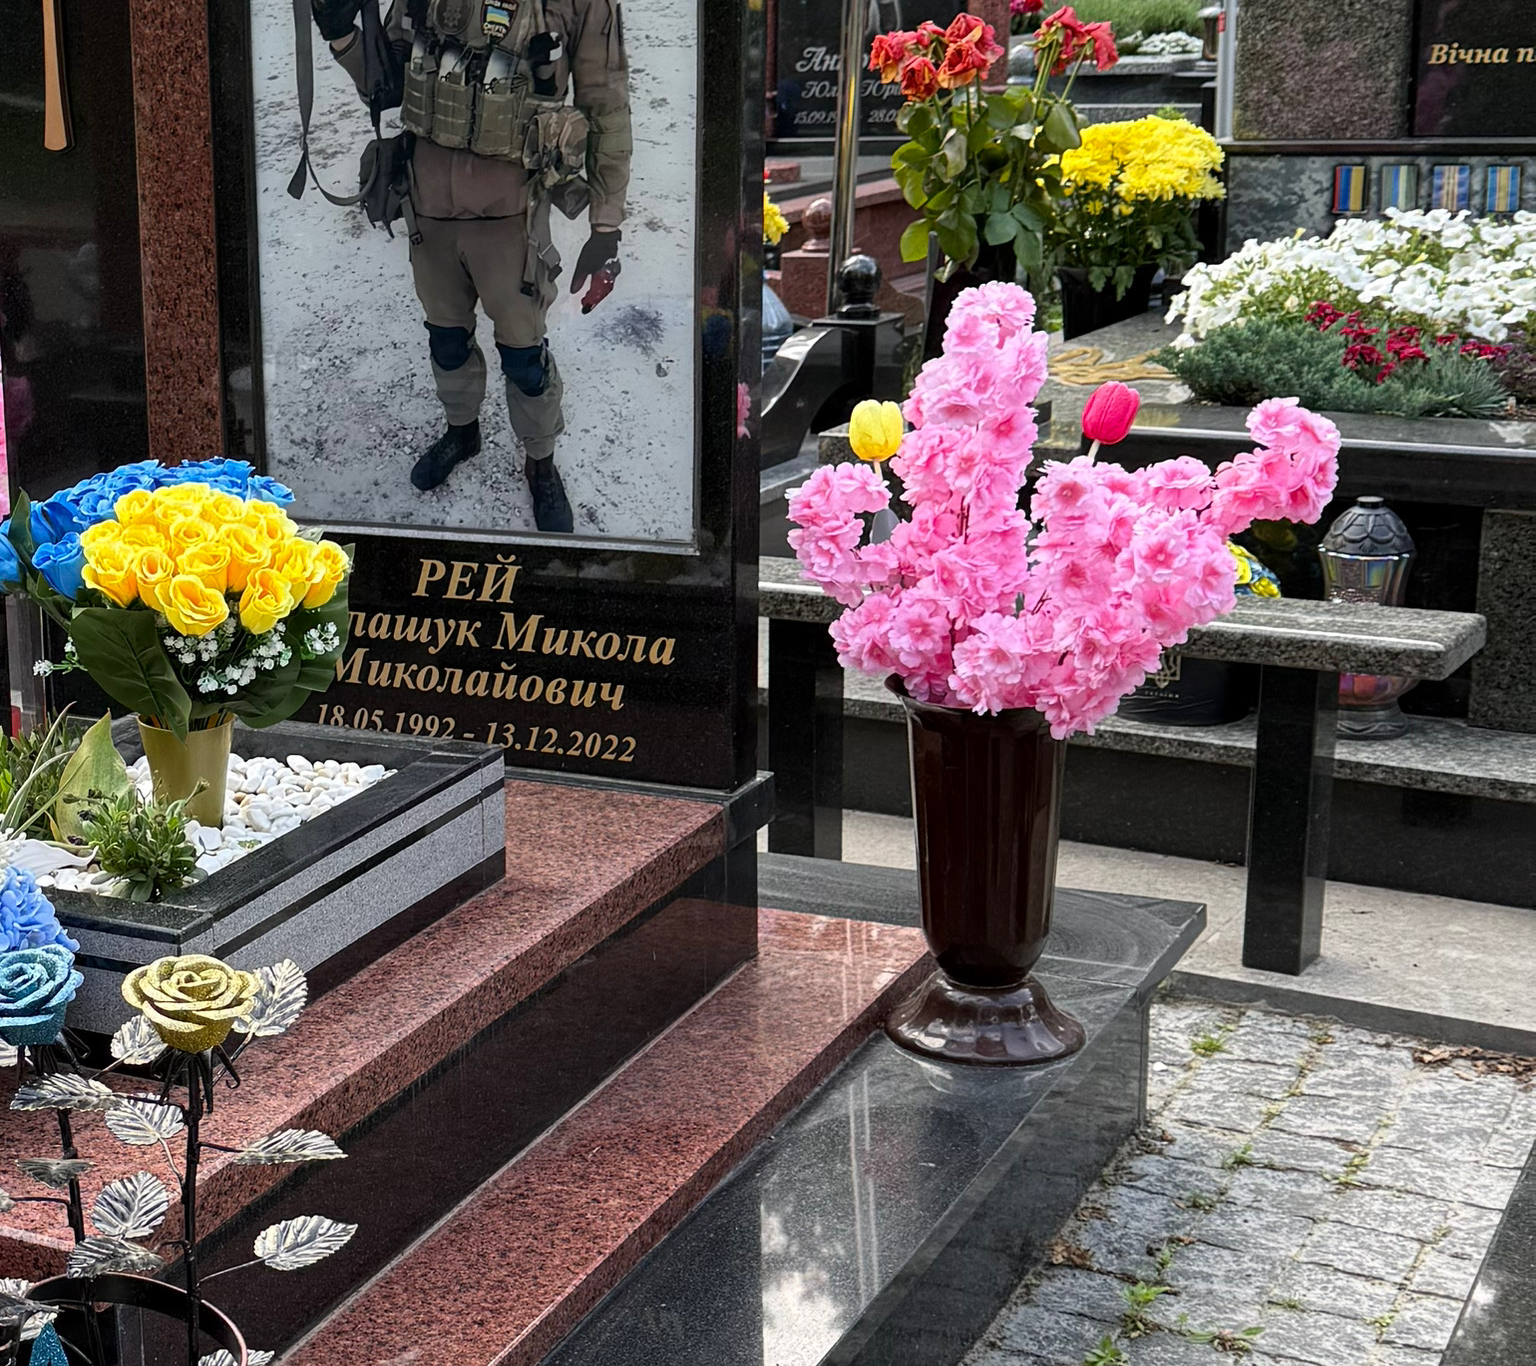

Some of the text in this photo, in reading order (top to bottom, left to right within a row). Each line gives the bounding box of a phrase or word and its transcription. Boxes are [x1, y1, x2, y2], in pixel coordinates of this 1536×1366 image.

[1428, 42, 1510, 66] Вічна
[411, 553, 523, 604] РЕЙ
[347, 610, 677, 667] лашук Микола
[335, 646, 626, 712] Миколайович
[317, 703, 456, 740] 18.05.1992
[486, 721, 638, 764] 13.12.2022
